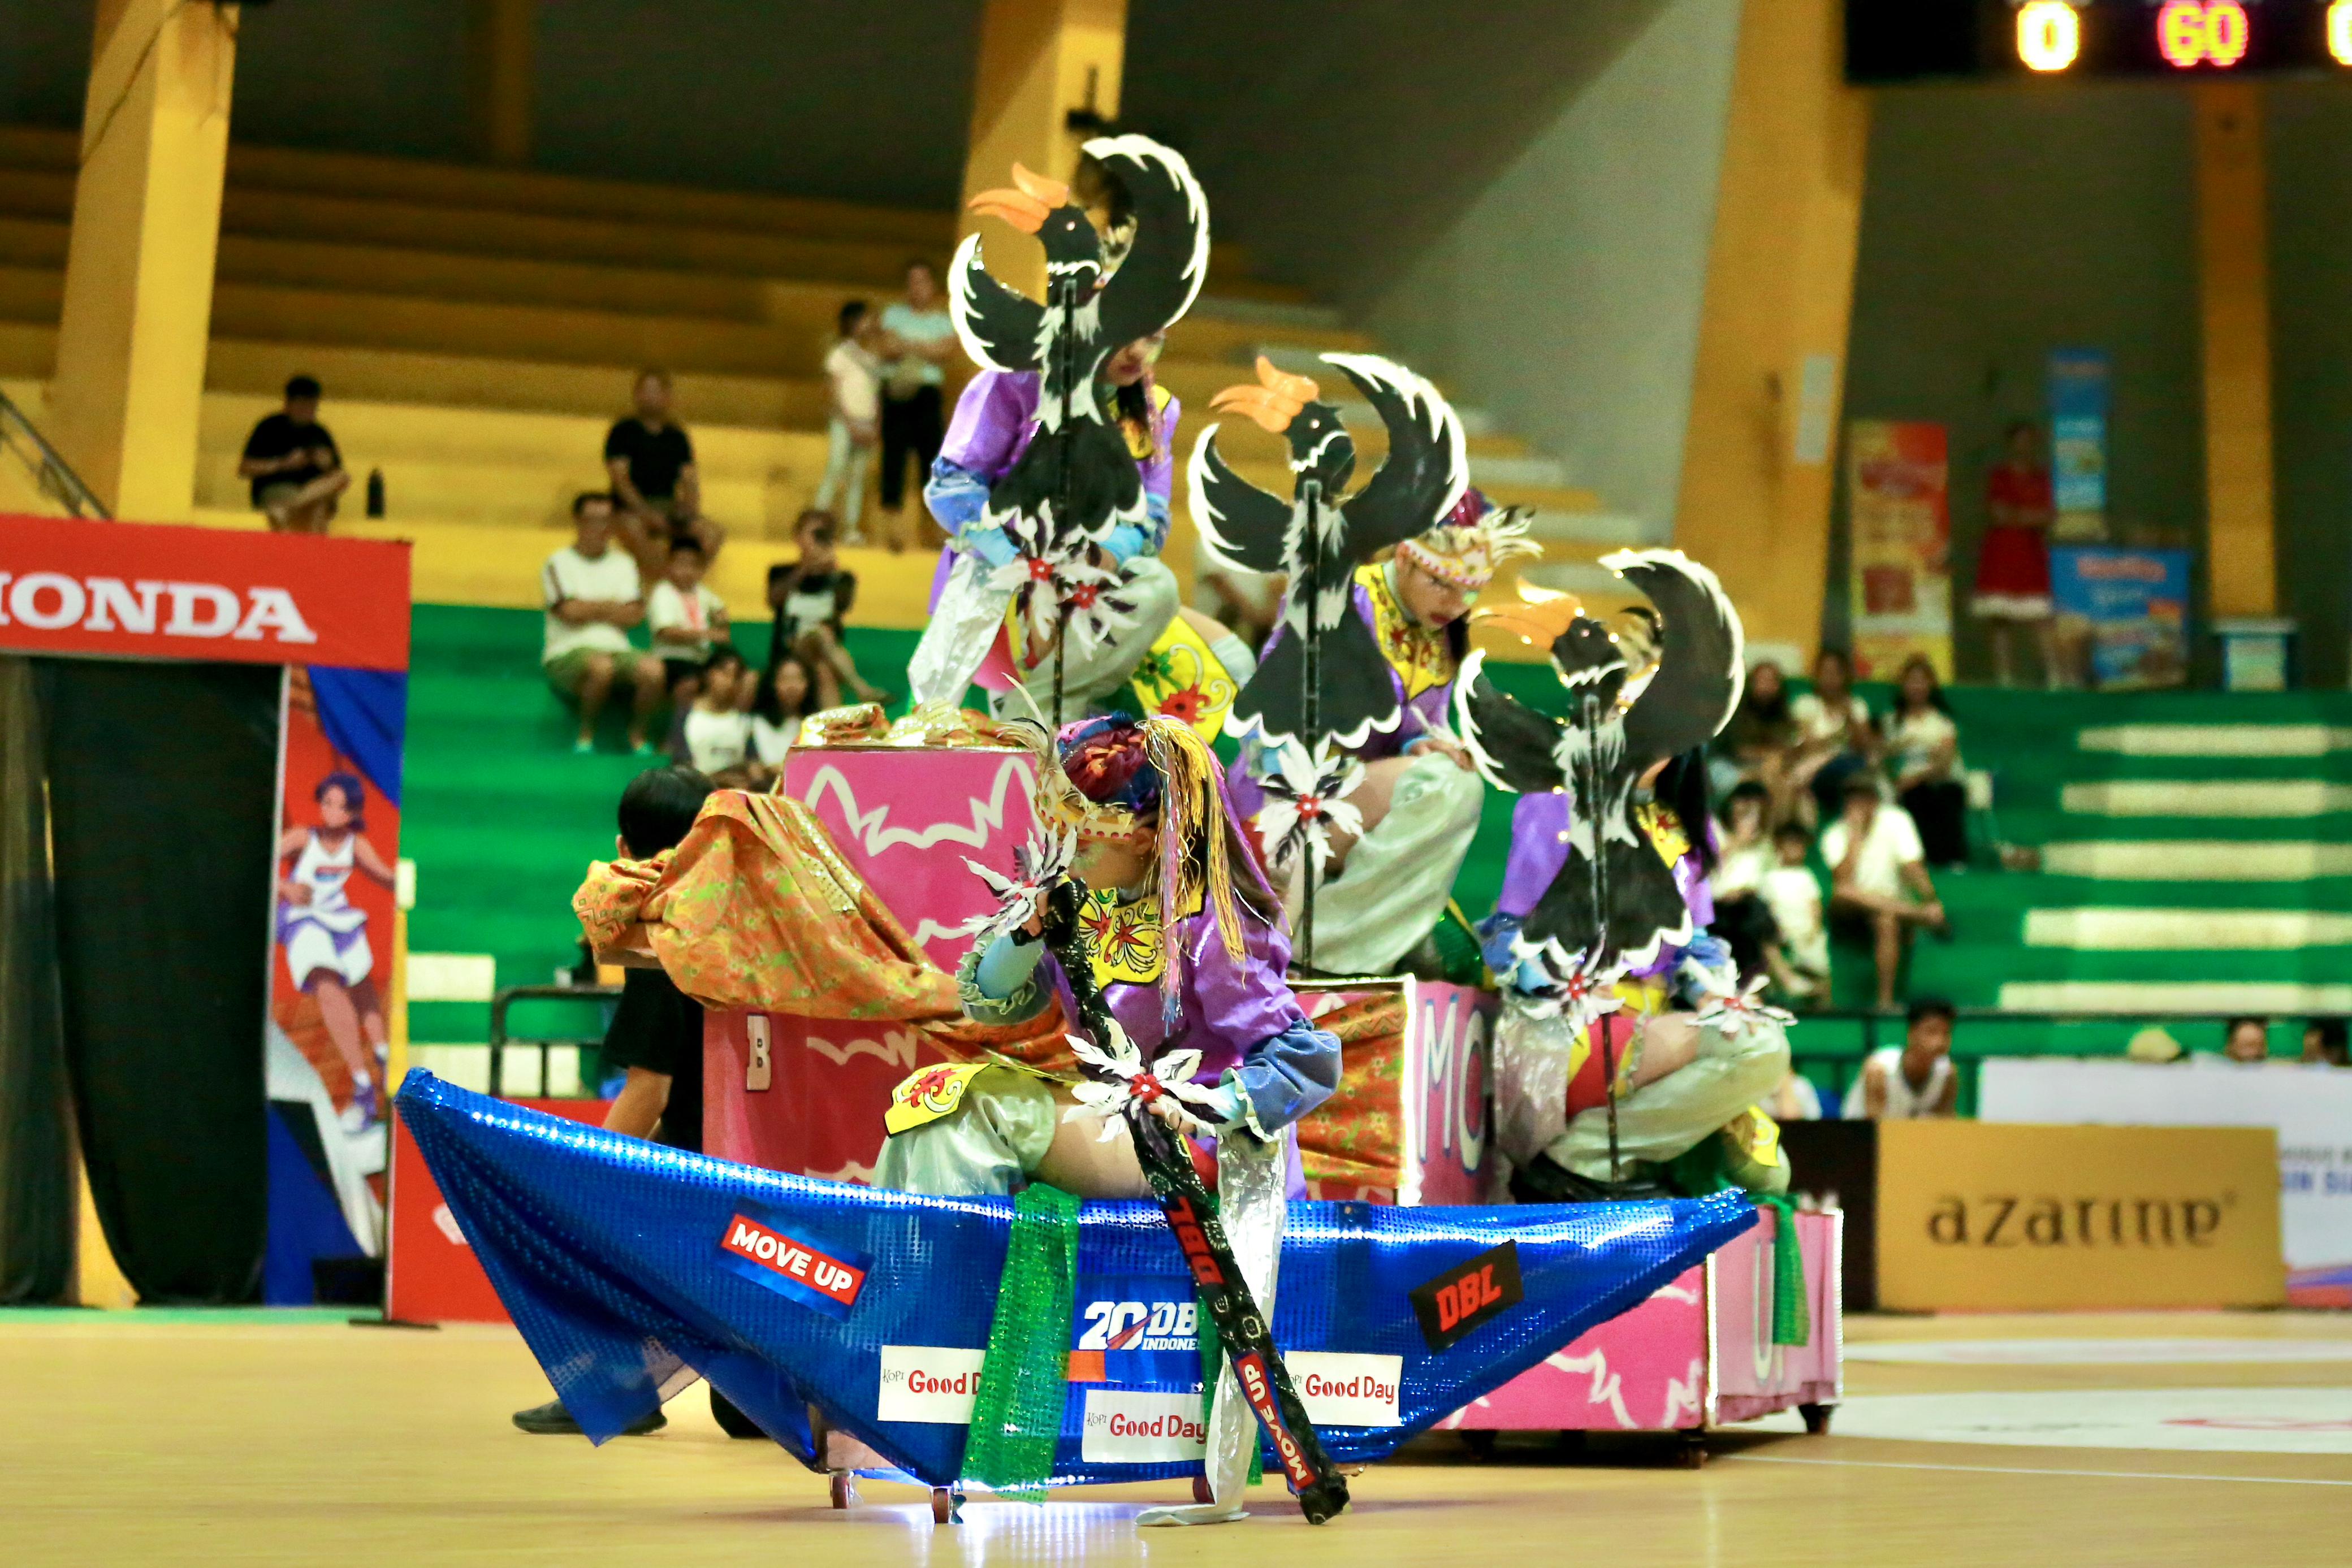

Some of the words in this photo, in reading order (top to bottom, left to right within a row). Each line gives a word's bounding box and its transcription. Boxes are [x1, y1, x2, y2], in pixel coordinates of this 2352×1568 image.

[2017, 0, 2079, 71] 0
[2157, 0, 2248, 67] 60
[0, 571, 318, 644] ONDA
[731, 1223, 812, 1277] MOVE
[814, 1261, 853, 1292] UP
[1166, 1196, 1225, 1285] DBL
[1079, 1301, 1148, 1350] 20
[1146, 1302, 1199, 1336] DB
[1436, 1263, 1502, 1332] DBL
[1142, 1337, 1200, 1350] INDONE
[909, 1370, 967, 1394] Good
[1244, 1364, 1266, 1402] UP
[1305, 1374, 1359, 1398] Good
[1364, 1376, 1394, 1405] Day
[1110, 1413, 1164, 1437] Good
[1168, 1415, 1207, 1445] Day
[1260, 1405, 1308, 1481] MOVE
